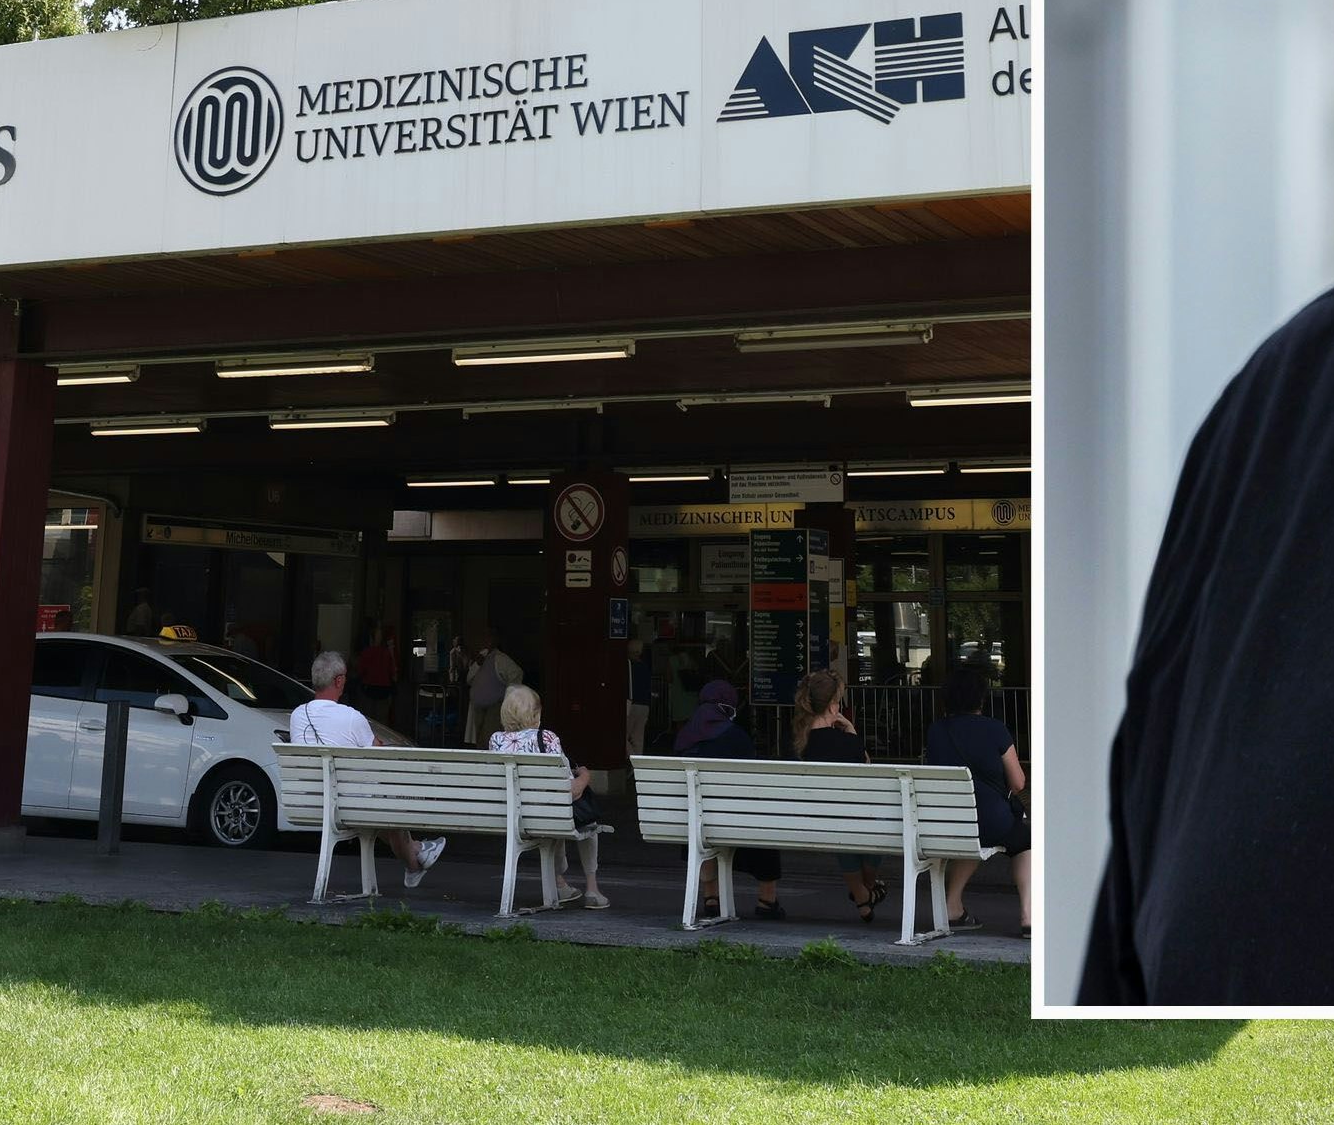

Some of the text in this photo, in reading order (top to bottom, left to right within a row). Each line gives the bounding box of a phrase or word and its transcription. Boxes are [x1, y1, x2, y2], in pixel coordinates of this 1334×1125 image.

[297, 53, 588, 116] MEDIZINISCHE
[295, 91, 690, 163] UNIVERSITÄT WIEN
[639, 509, 763, 527] MEDIZINISCHER
